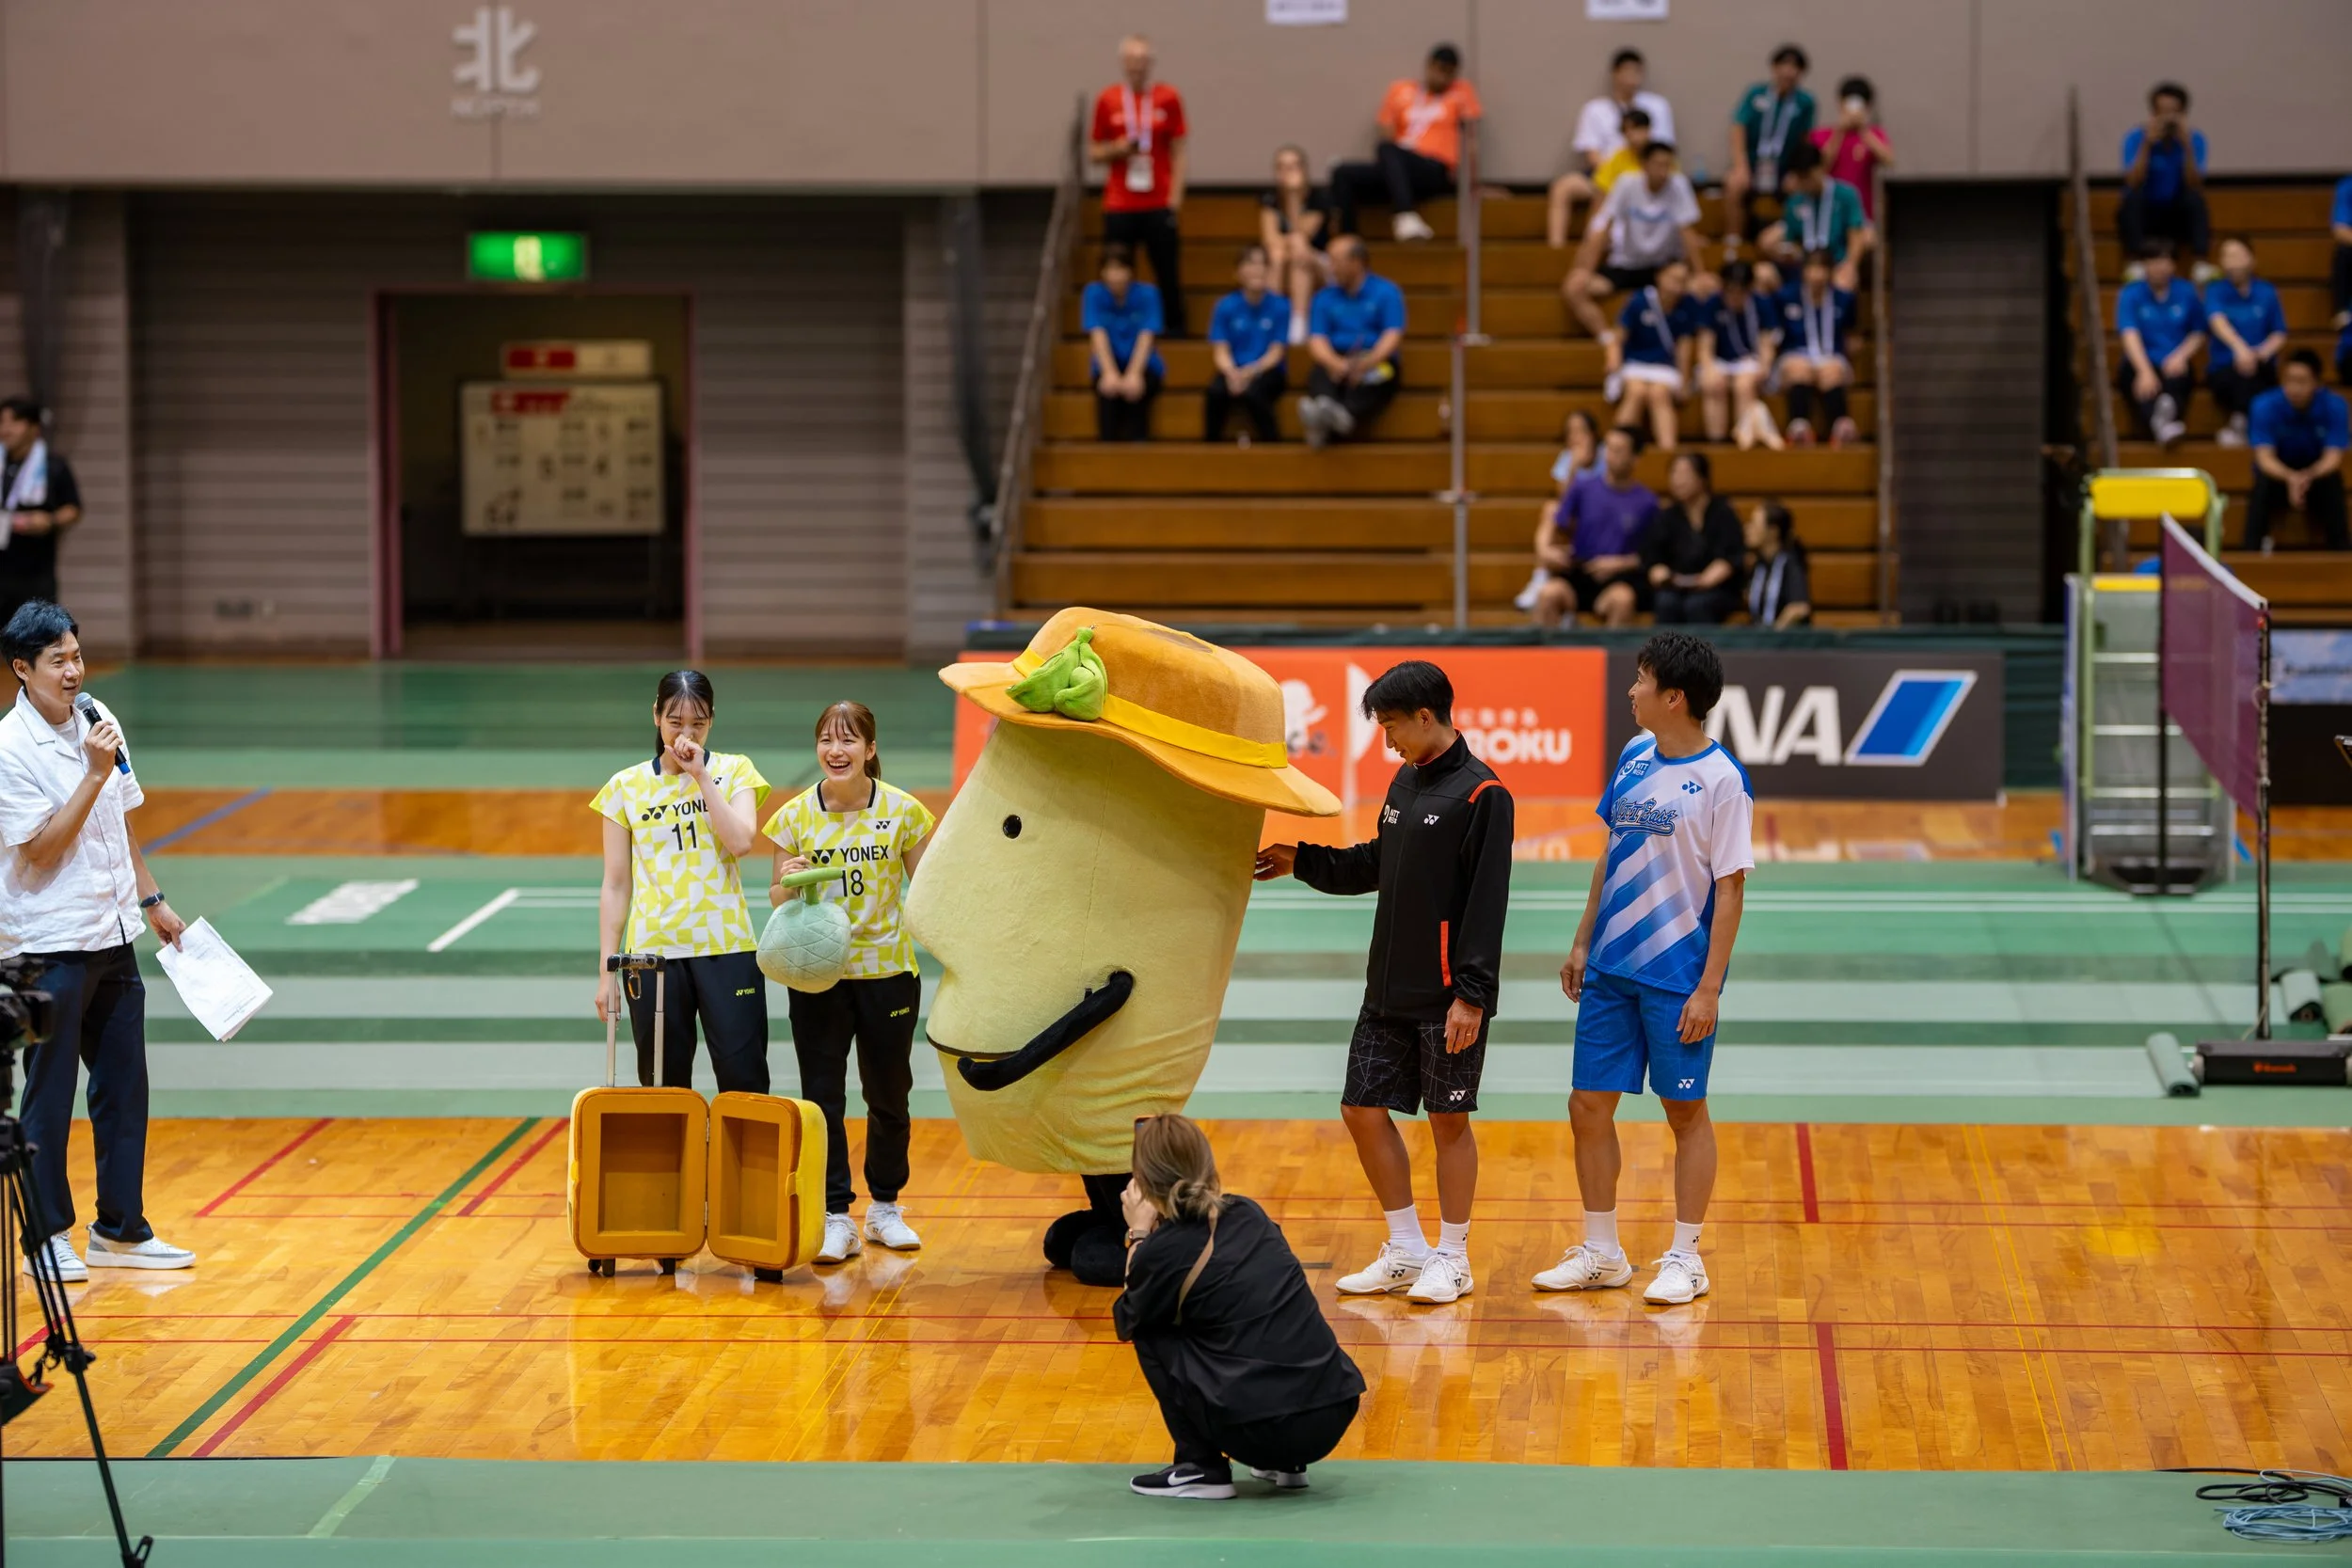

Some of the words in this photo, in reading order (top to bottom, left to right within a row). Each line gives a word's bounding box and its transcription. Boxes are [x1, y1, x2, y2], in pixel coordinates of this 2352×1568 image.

[452, 6, 539, 92] 北
[1705, 686, 1841, 765] NA
[672, 821, 697, 850] 11
[840, 846, 889, 863] YONEX
[842, 869, 865, 897] 18
